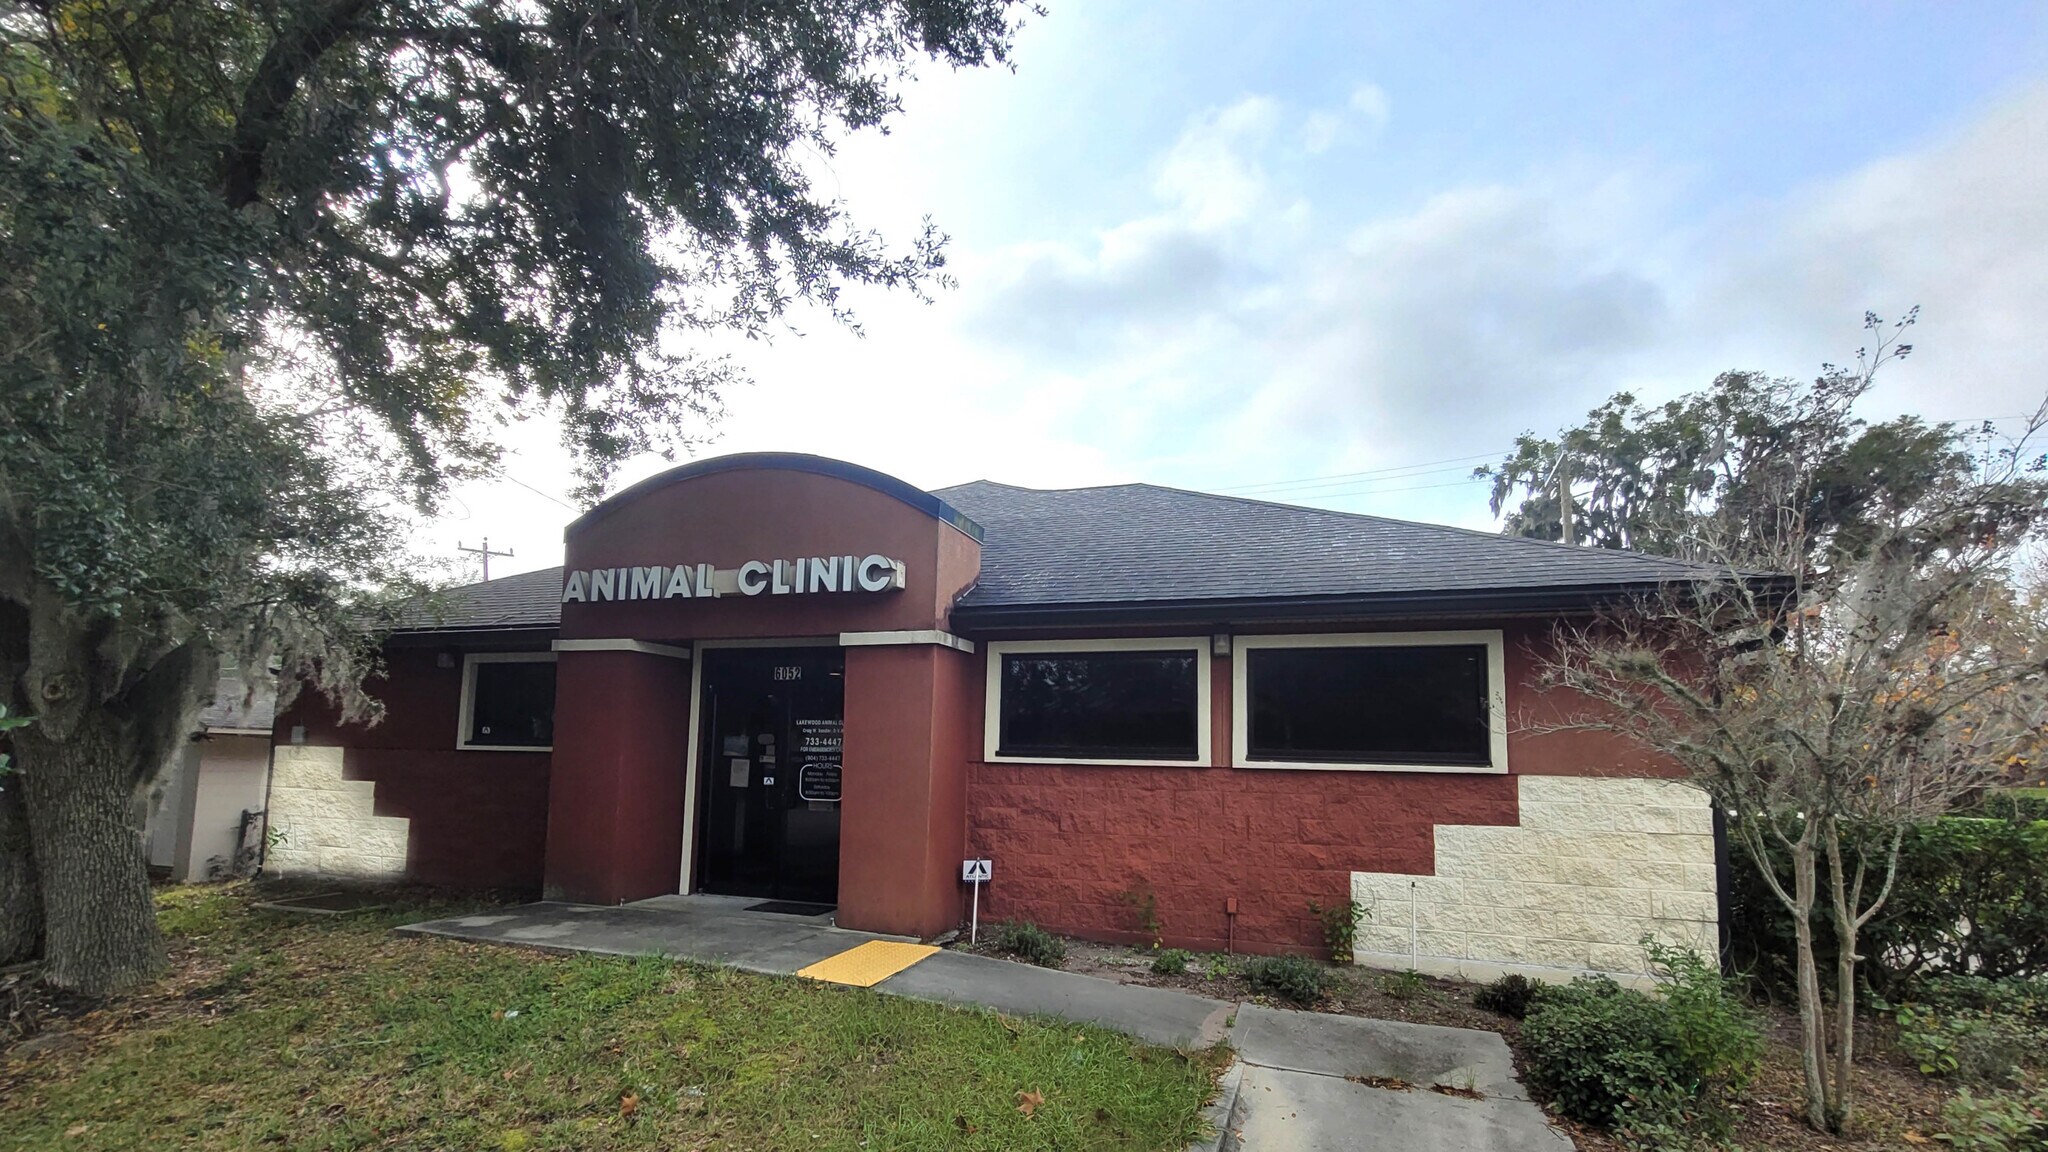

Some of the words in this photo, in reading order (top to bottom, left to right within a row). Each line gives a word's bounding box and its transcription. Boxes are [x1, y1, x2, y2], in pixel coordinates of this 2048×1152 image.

[562, 563, 716, 602] ANIMAL
[737, 554, 899, 596] CLINIC
[775, 667, 801, 680] 6052
[805, 737, 842, 746] 733-4447
